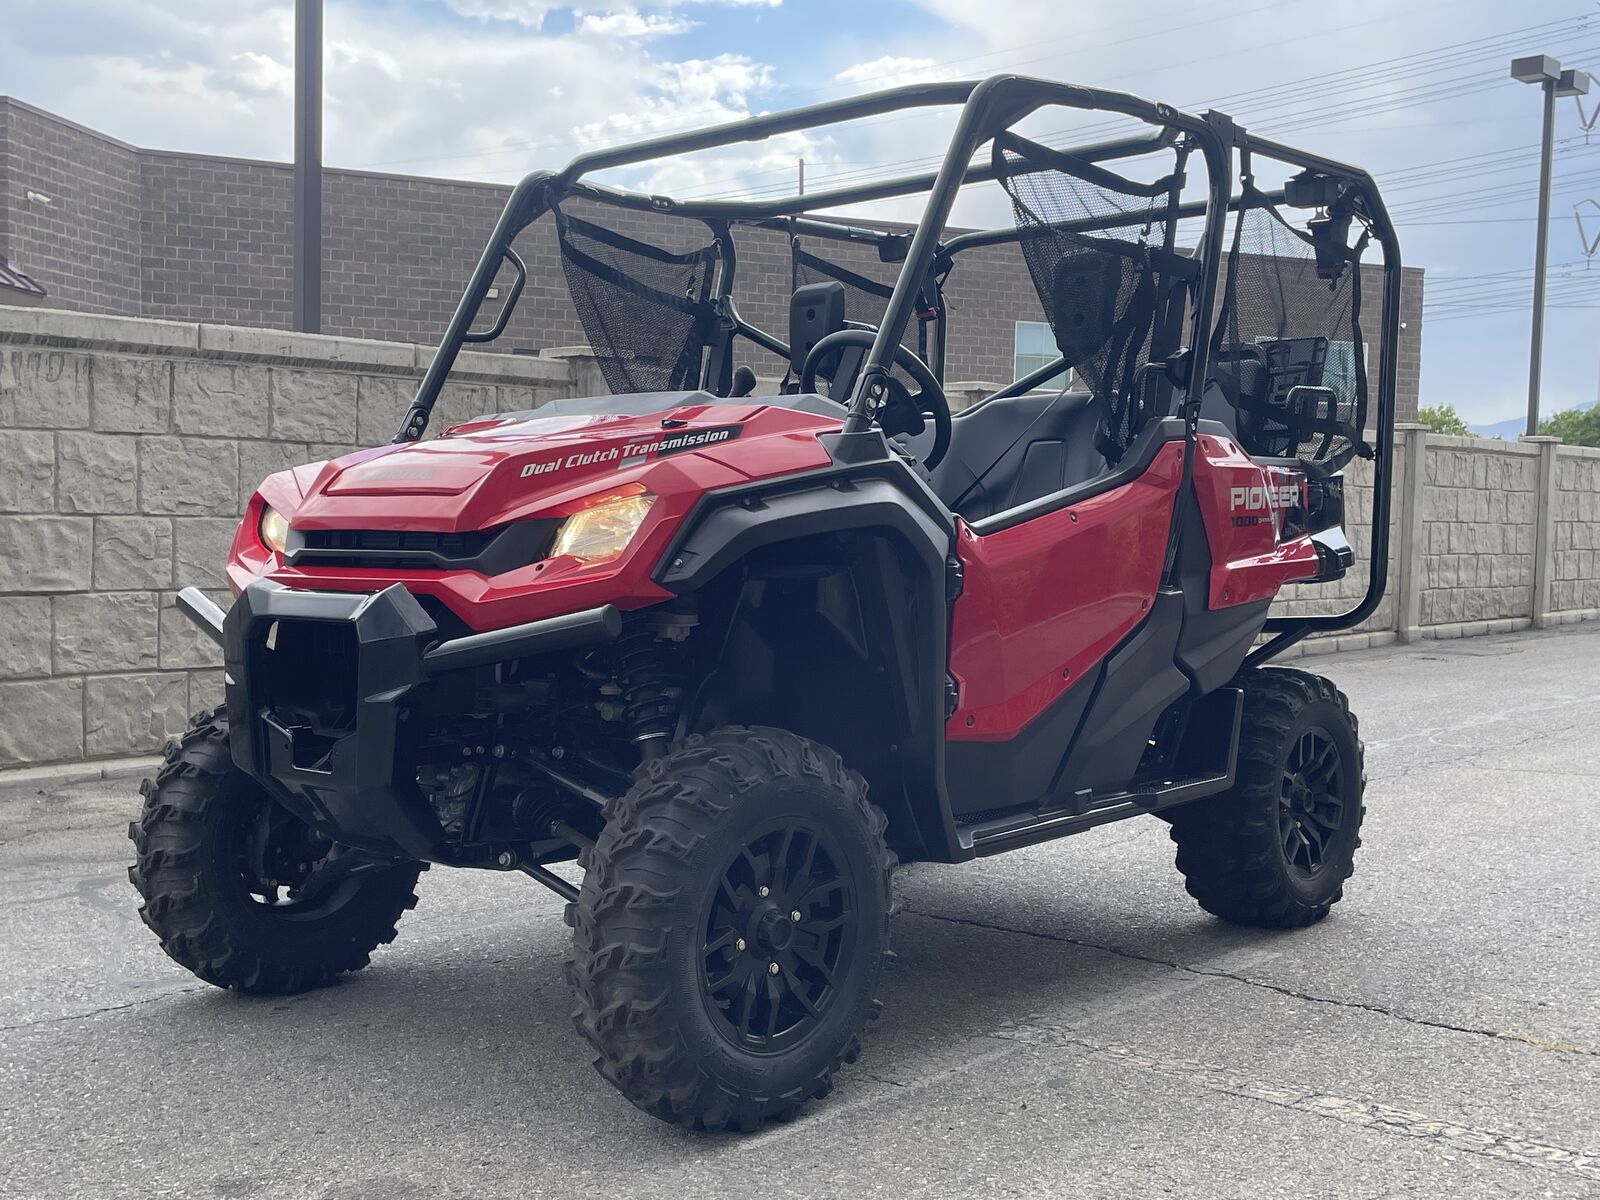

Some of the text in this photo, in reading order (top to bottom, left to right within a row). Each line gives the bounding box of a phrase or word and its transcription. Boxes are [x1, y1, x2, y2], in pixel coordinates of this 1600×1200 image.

[520, 430, 729, 478] Dual Clutch Transmission
[1231, 485, 1299, 511] PIONEER
